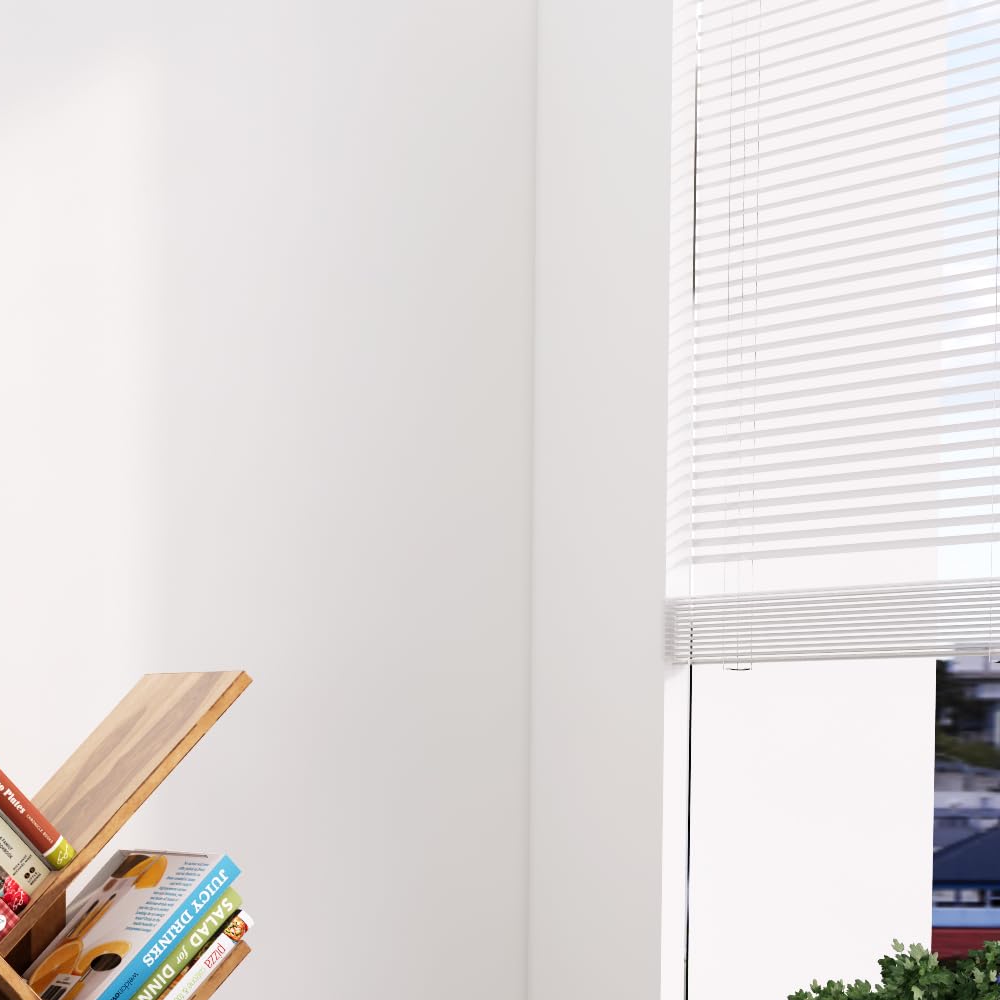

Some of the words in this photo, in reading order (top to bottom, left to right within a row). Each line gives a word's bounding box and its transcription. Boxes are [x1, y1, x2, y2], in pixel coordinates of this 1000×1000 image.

[3, 788, 26, 814] Plates
[191, 870, 228, 913] JUICY
[143, 910, 193, 967] DRINKS
[190, 898, 233, 947] SALAD
[177, 945, 189, 964] for
[204, 943, 226, 968] pizza
